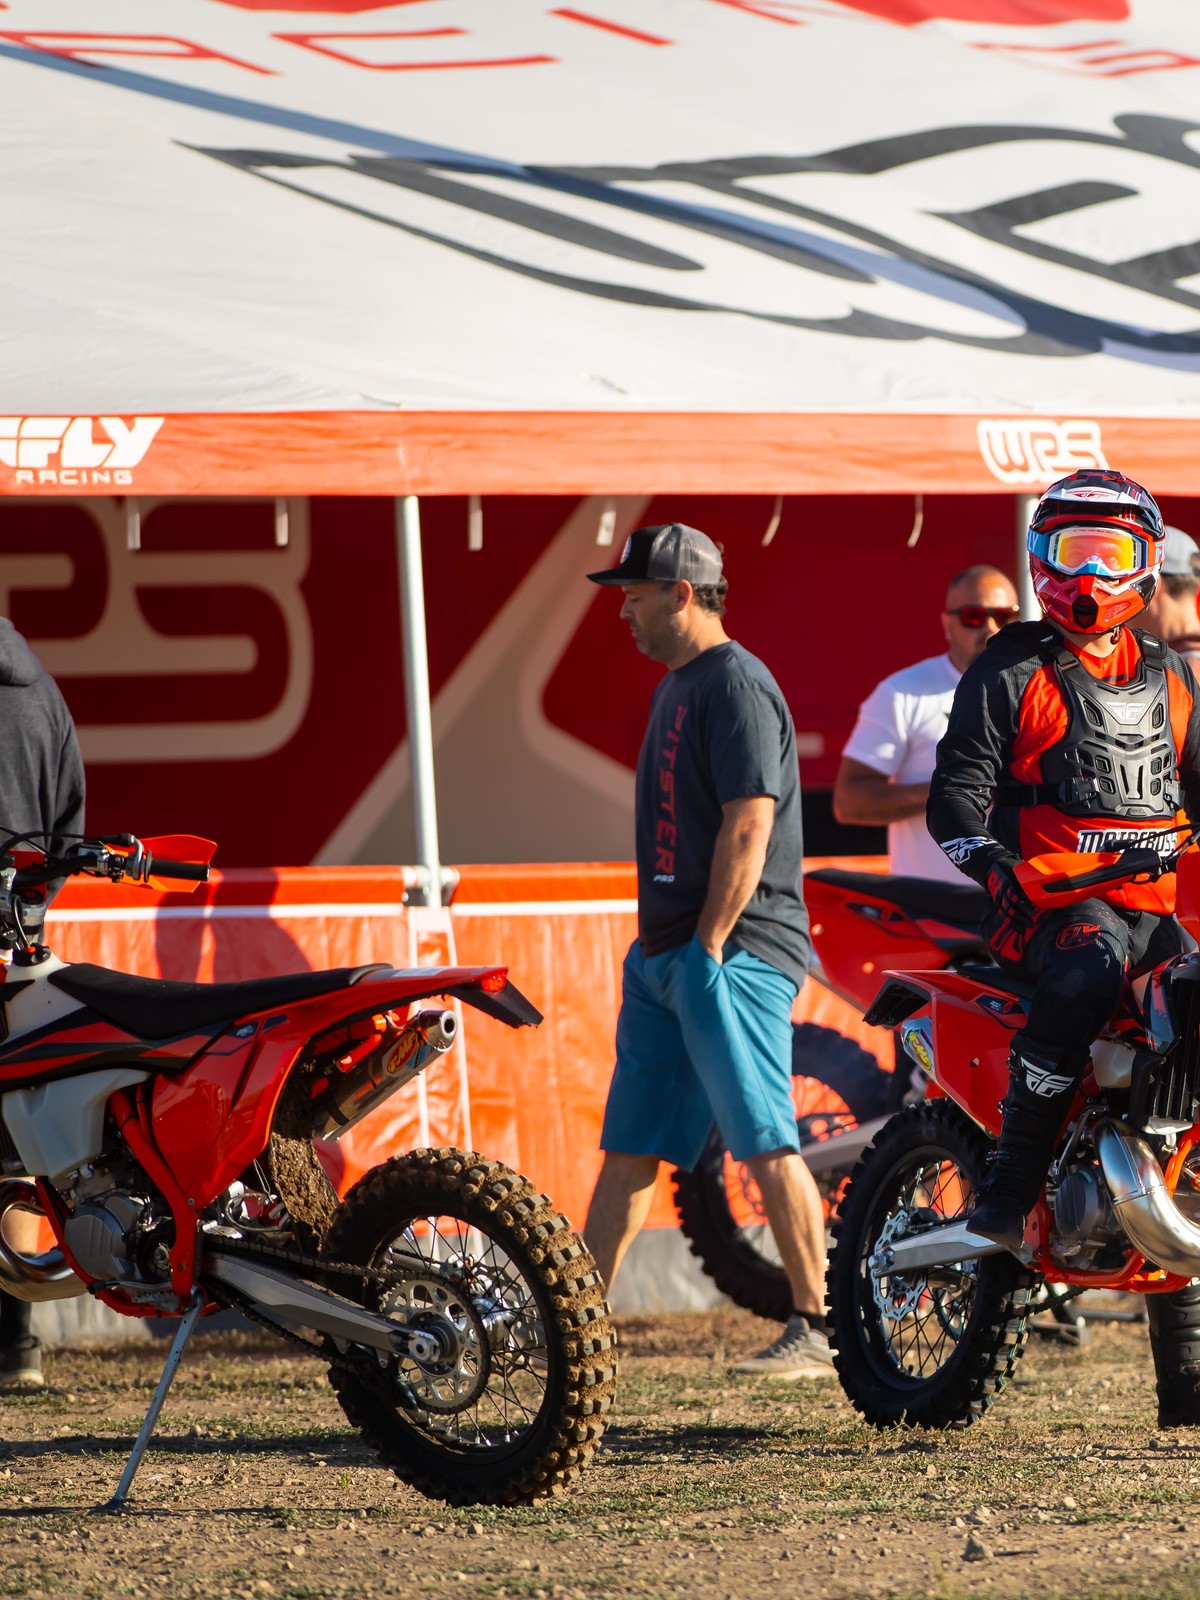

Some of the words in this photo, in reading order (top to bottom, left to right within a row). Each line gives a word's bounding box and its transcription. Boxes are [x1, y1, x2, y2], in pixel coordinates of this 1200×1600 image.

[0, 416, 165, 468] FLY
[16, 470, 133, 485] RACING
[653, 874, 675, 882] PRO
